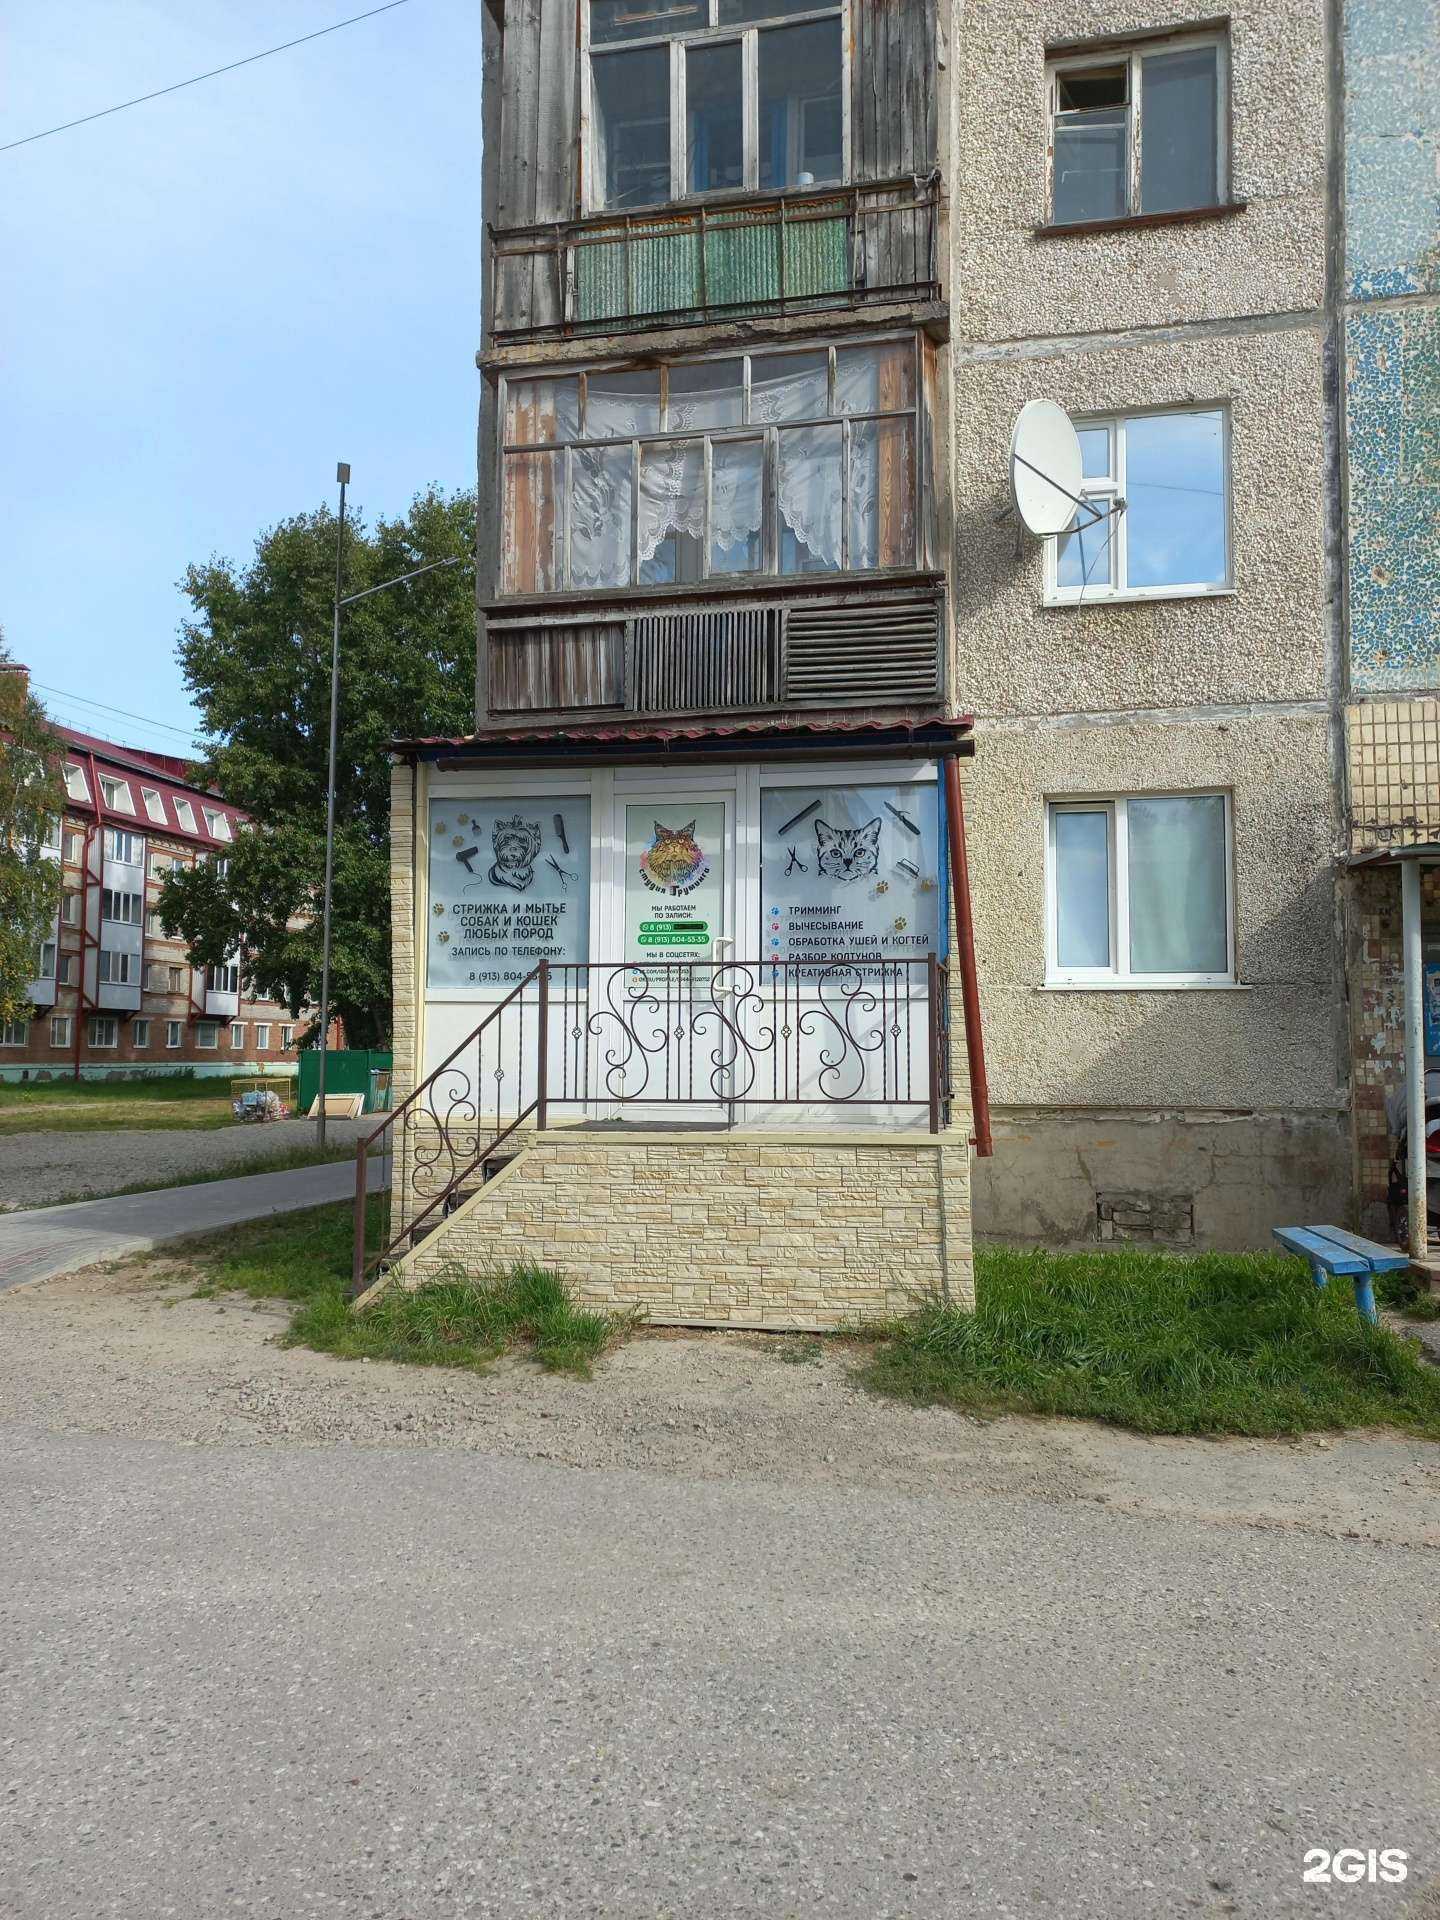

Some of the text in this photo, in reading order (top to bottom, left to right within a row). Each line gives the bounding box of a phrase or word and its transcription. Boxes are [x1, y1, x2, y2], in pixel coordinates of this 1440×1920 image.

[452, 903, 566, 914] СТРИЖКА И МЫТЬЕ
[788, 906, 842, 915] ТРИММИНГ
[460, 916, 558, 927] СОБАК И КОШЕК
[788, 921, 864, 931] ВЫЧЕСЫВАНИЕ
[464, 928, 554, 940] ЛЮБЫХ ПОРОД
[788, 934, 929, 946] ОБРАБОТКА УШЕЙ И КОГТЕЙ
[452, 946, 566, 956] ЗАПИСЬ ПО ТЕЛЕФОНУ:
[788, 952, 882, 961] РАЗБОР КОЛТУНОВ
[469, 972, 475, 980] 8
[479, 972, 500, 982] (913)
